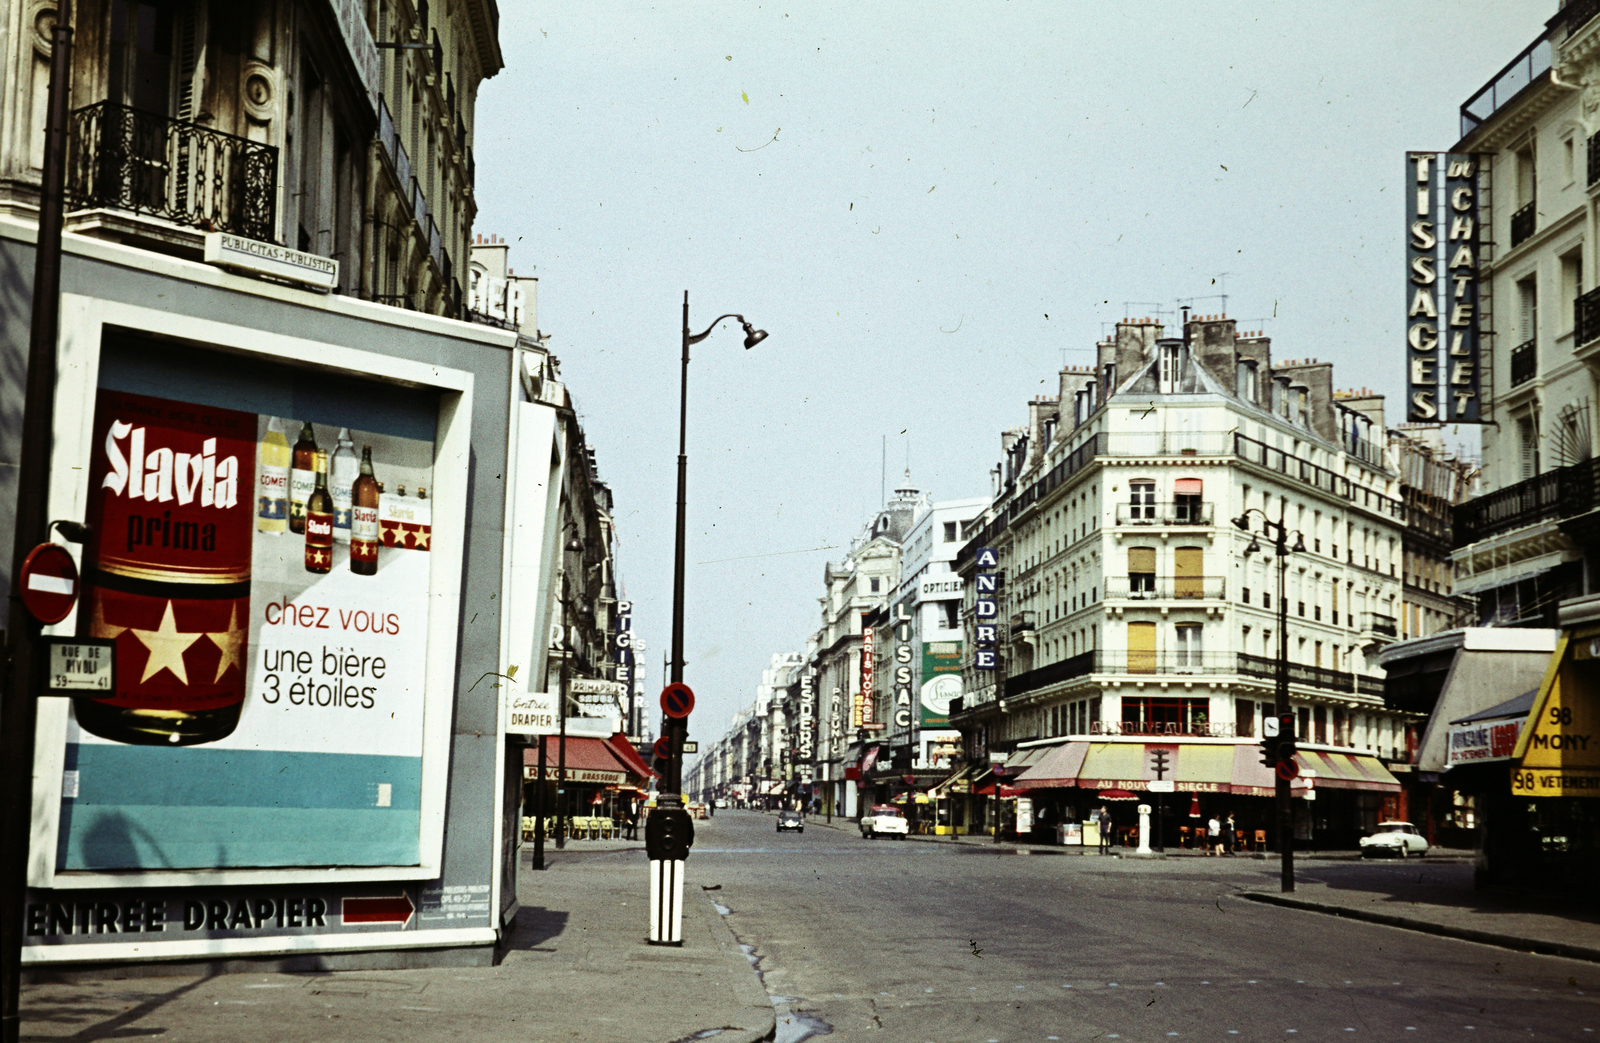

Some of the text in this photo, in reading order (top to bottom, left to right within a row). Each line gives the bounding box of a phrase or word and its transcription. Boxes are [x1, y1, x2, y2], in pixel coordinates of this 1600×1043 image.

[1408, 153, 1438, 419] TISSAGES
[1447, 161, 1476, 415] DU CHATELET
[102, 418, 238, 509] Slavia
[260, 474, 287, 488] COMET
[292, 479, 315, 492] COME
[127, 510, 216, 553] prima
[265, 595, 400, 636] chez vous
[61, 646, 100, 659] RUE DE
[264, 645, 386, 679] une bière
[615, 600, 632, 697] PIGIER
[863, 627, 873, 669] PARIS
[895, 602, 913, 728] LISSAC
[55, 674, 68, 687] 39
[66, 659, 97, 674] RIVOLI
[262, 674, 280, 704] 3
[289, 675, 375, 710] étoiles
[511, 713, 552, 727] DRAPIER
[800, 675, 813, 759] ESDERS
[831, 687, 840, 754] PRISUNIC
[1549, 707, 1573, 726] 98
[581, 771, 619, 782] BRASSERIE
[1096, 780, 1113, 790] AU
[1177, 783, 1219, 792] SIECLE
[1514, 772, 1536, 790] 98
[184, 899, 328, 931] DRAPIER
